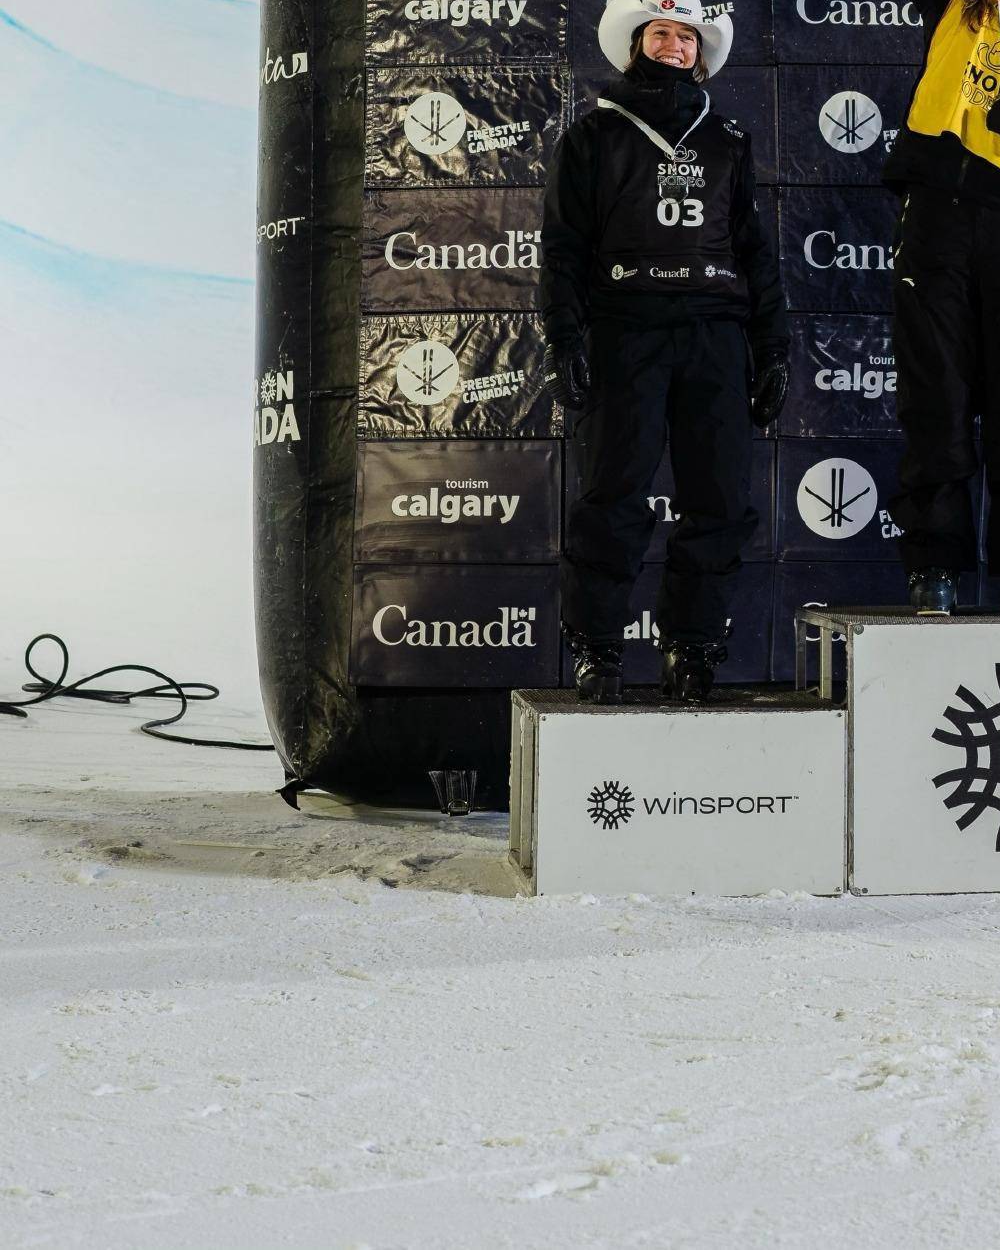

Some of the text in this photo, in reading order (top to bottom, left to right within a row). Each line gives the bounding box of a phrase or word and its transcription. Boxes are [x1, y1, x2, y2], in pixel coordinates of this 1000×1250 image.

[701, 1, 735, 17] STYLE
[466, 120, 531, 143] FREESTYLE
[468, 136, 518, 155] CANADA
[657, 163, 705, 178] SNOW
[657, 175, 706, 188] RODEO
[656, 197, 705, 227] 03
[385, 230, 541, 271] Canada
[650, 266, 690, 278] Canada
[869, 354, 896, 365] touri
[461, 369, 525, 392] FREESTYLE
[814, 362, 898, 399] calga
[462, 387, 512, 404] CANADA
[445, 478, 489, 490] tourism
[391, 487, 520, 524] calgary
[372, 604, 537, 648] Canada
